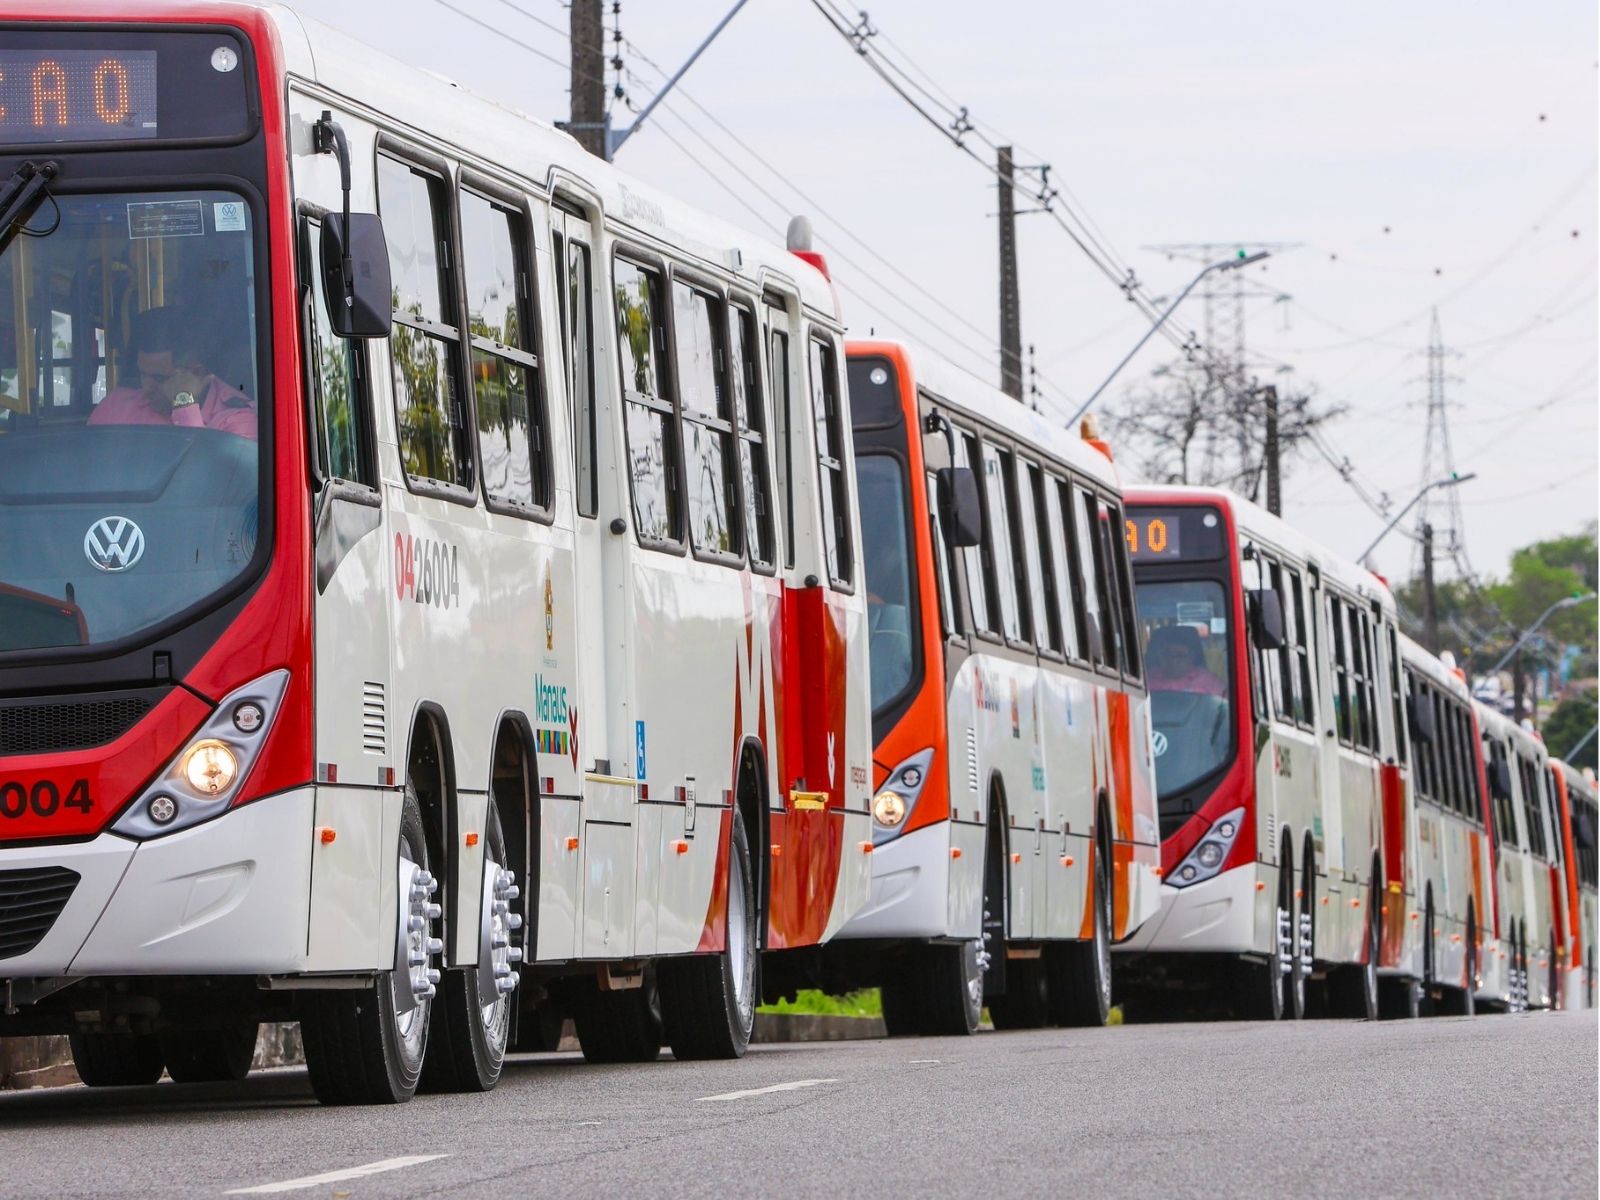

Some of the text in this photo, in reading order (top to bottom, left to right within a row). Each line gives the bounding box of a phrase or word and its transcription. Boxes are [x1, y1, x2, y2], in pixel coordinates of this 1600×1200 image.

[85, 516, 144, 570] VW
[394, 531, 460, 611] 0426004
[534, 672, 567, 725] Manaus
[0, 779, 95, 818] 004
